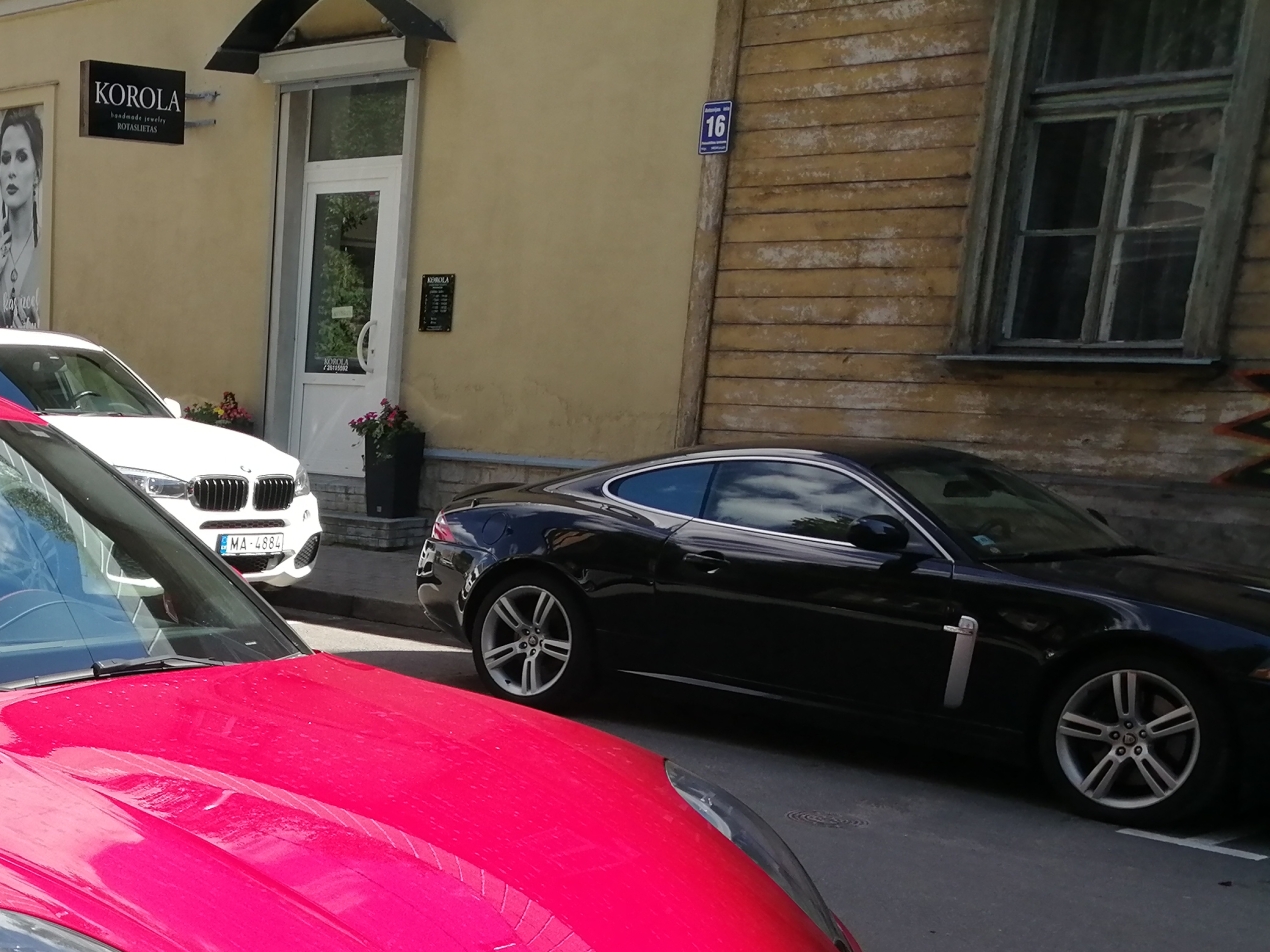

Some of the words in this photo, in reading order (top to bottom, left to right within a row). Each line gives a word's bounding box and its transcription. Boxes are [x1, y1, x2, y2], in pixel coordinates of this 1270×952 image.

[94, 80, 182, 113] KOROLA
[110, 111, 142, 121] handmade
[144, 116, 166, 125] jewelry
[706, 114, 726, 137] 16
[117, 122, 158, 134] ROTASLIETAS
[230, 536, 281, 551] MA-4884
